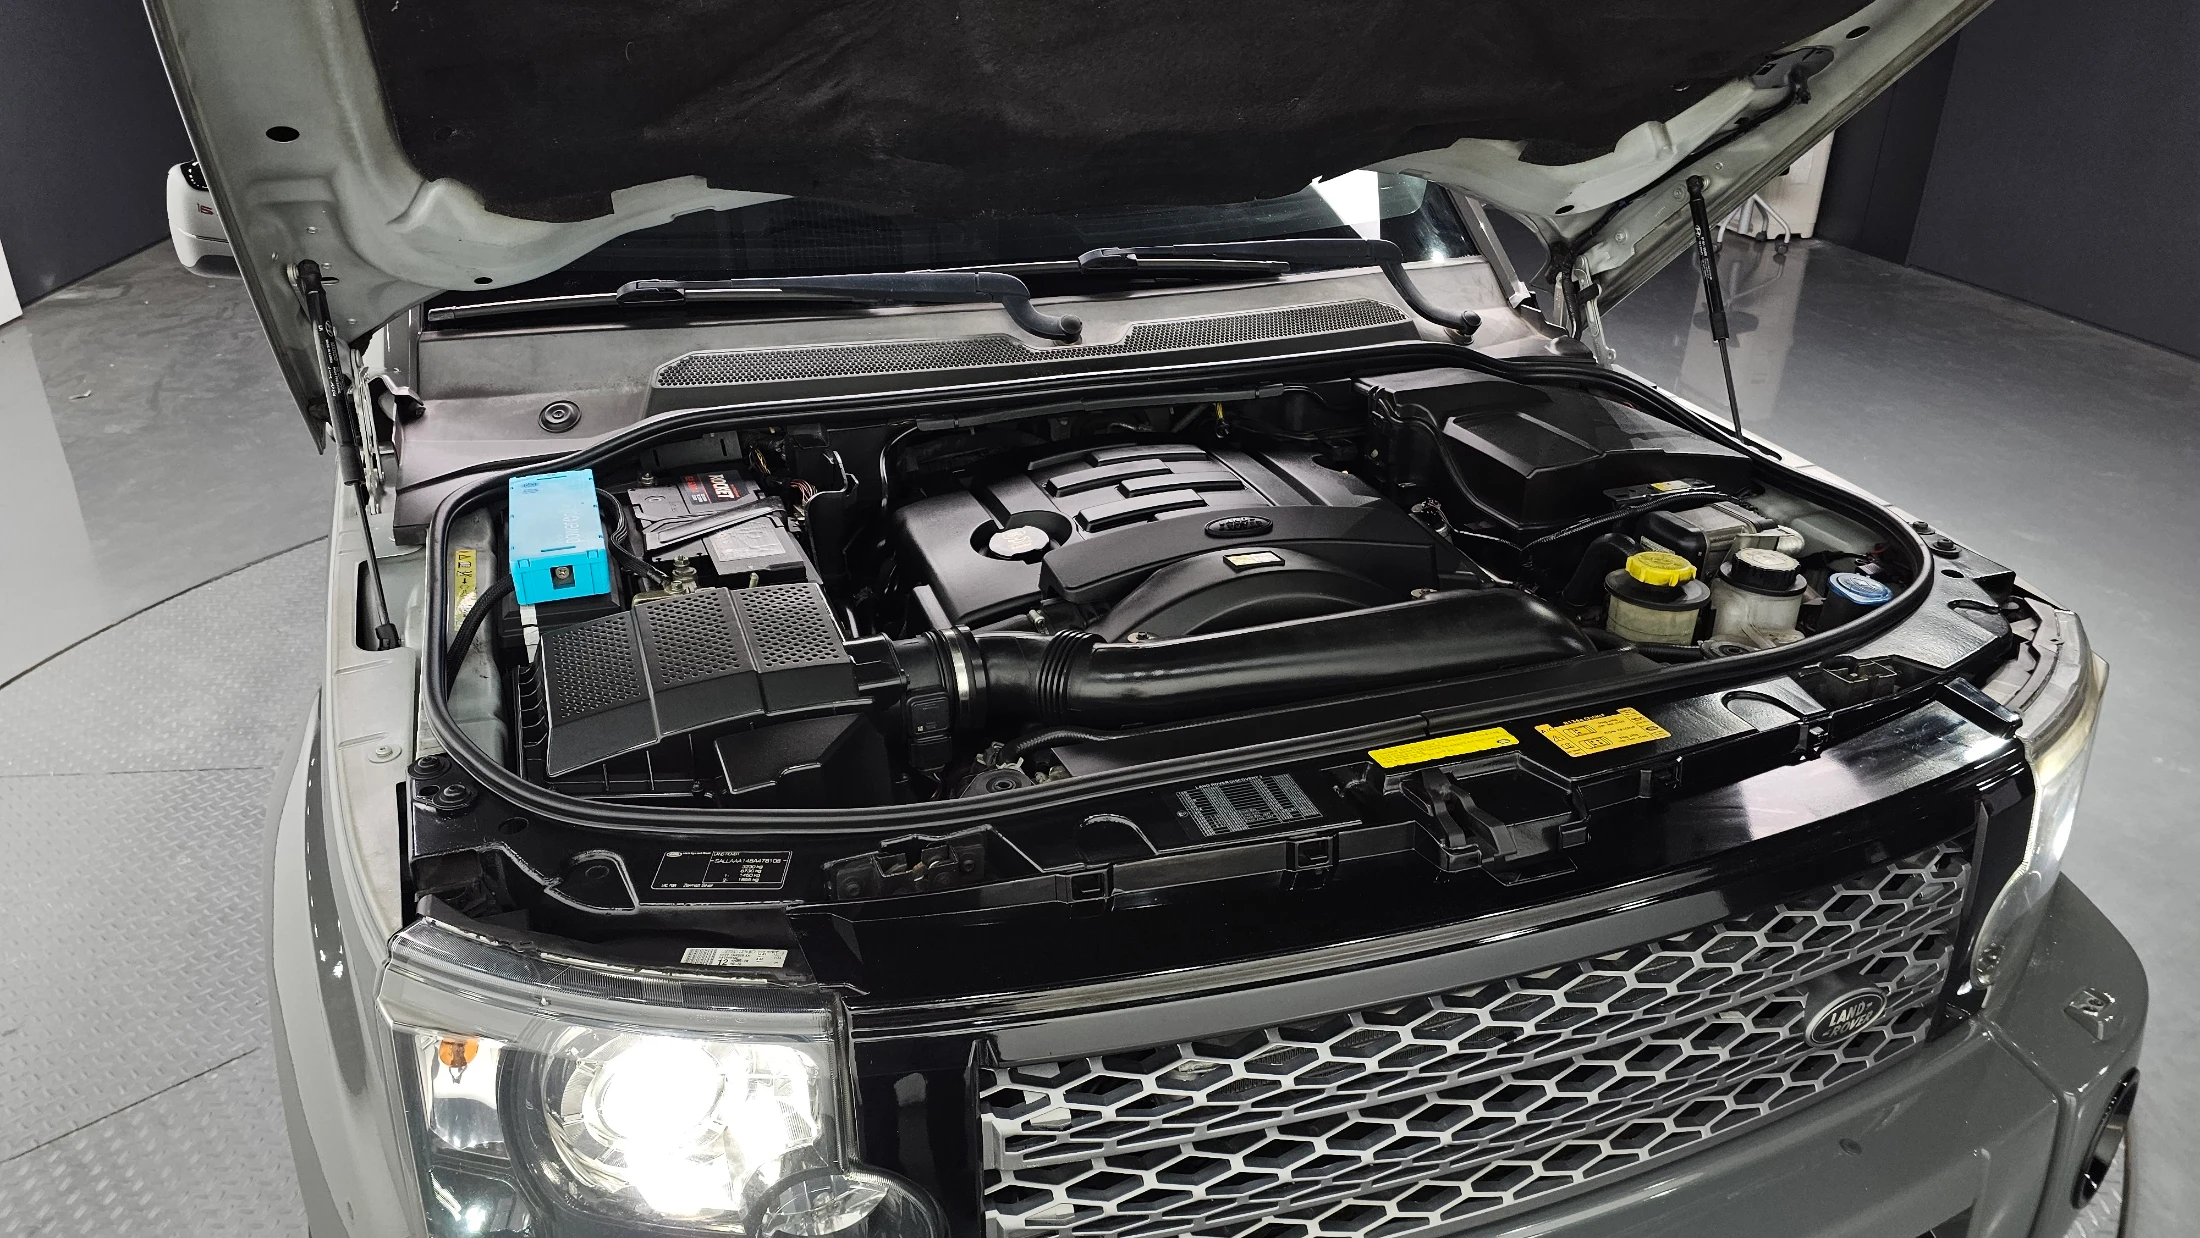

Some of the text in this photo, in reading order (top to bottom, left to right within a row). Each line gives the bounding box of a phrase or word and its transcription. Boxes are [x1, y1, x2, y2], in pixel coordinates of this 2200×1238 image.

[708, 474, 735, 499] ROCKET
[1829, 1001, 1866, 1028] LAND
[1829, 1010, 1874, 1038] ROVER
